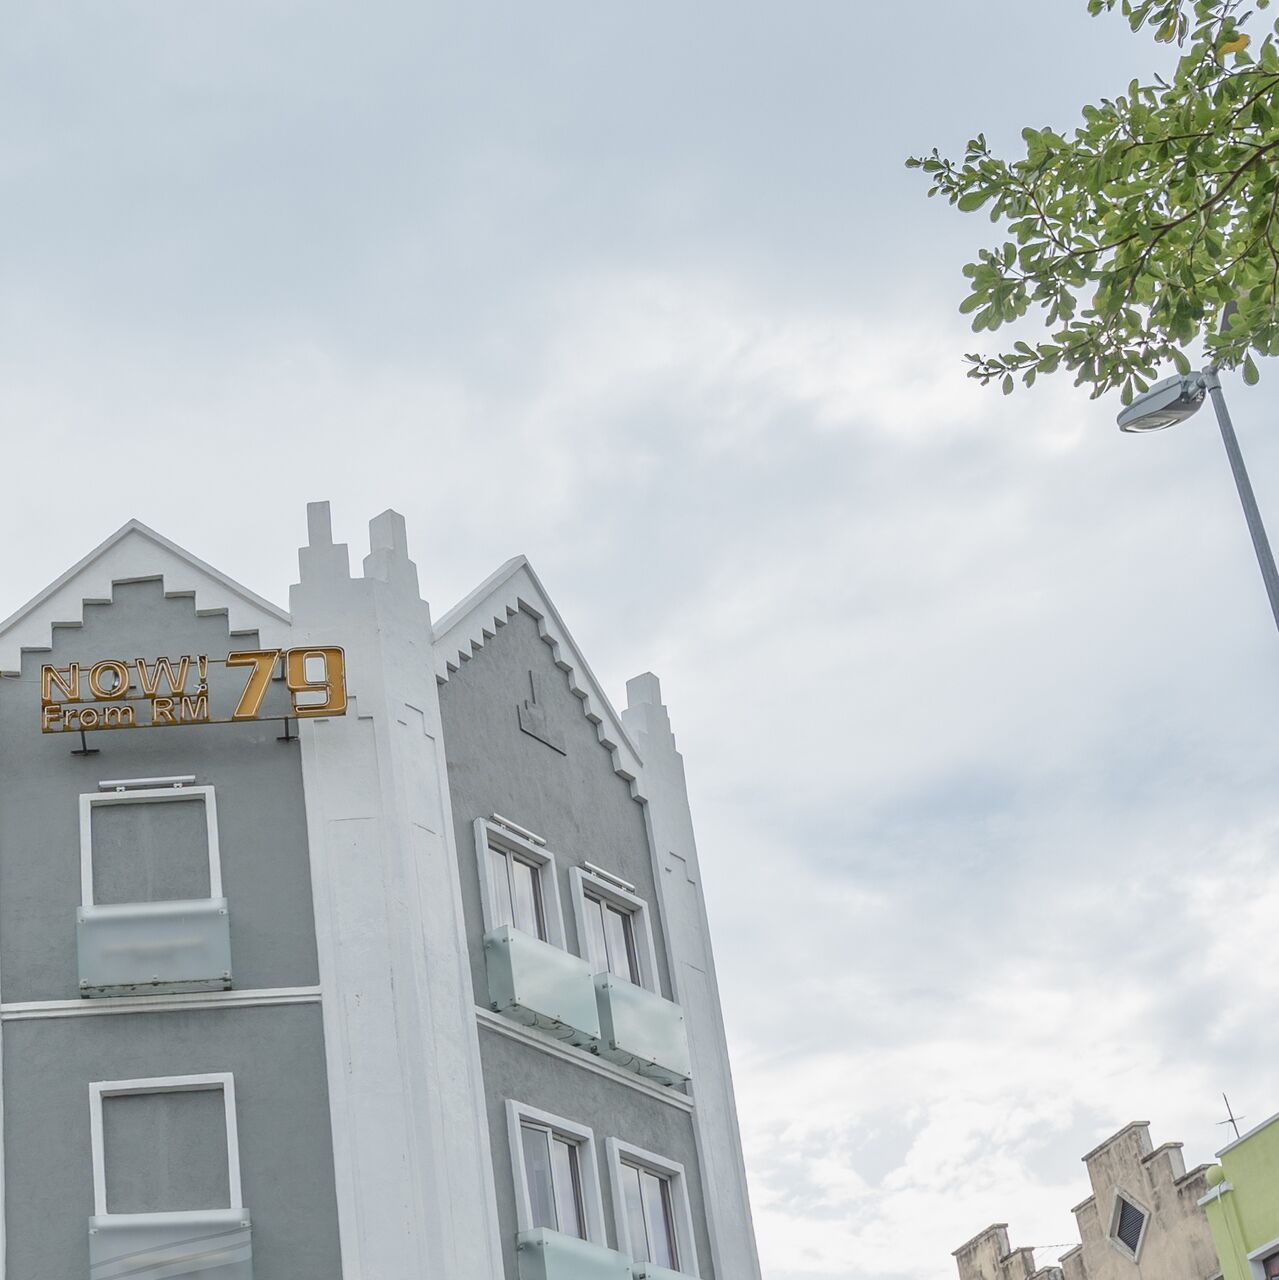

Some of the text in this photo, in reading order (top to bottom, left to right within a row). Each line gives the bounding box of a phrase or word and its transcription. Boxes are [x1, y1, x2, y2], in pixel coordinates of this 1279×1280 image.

[41, 646, 348, 719] NOW! 79
[42, 695, 209, 733] From RM
